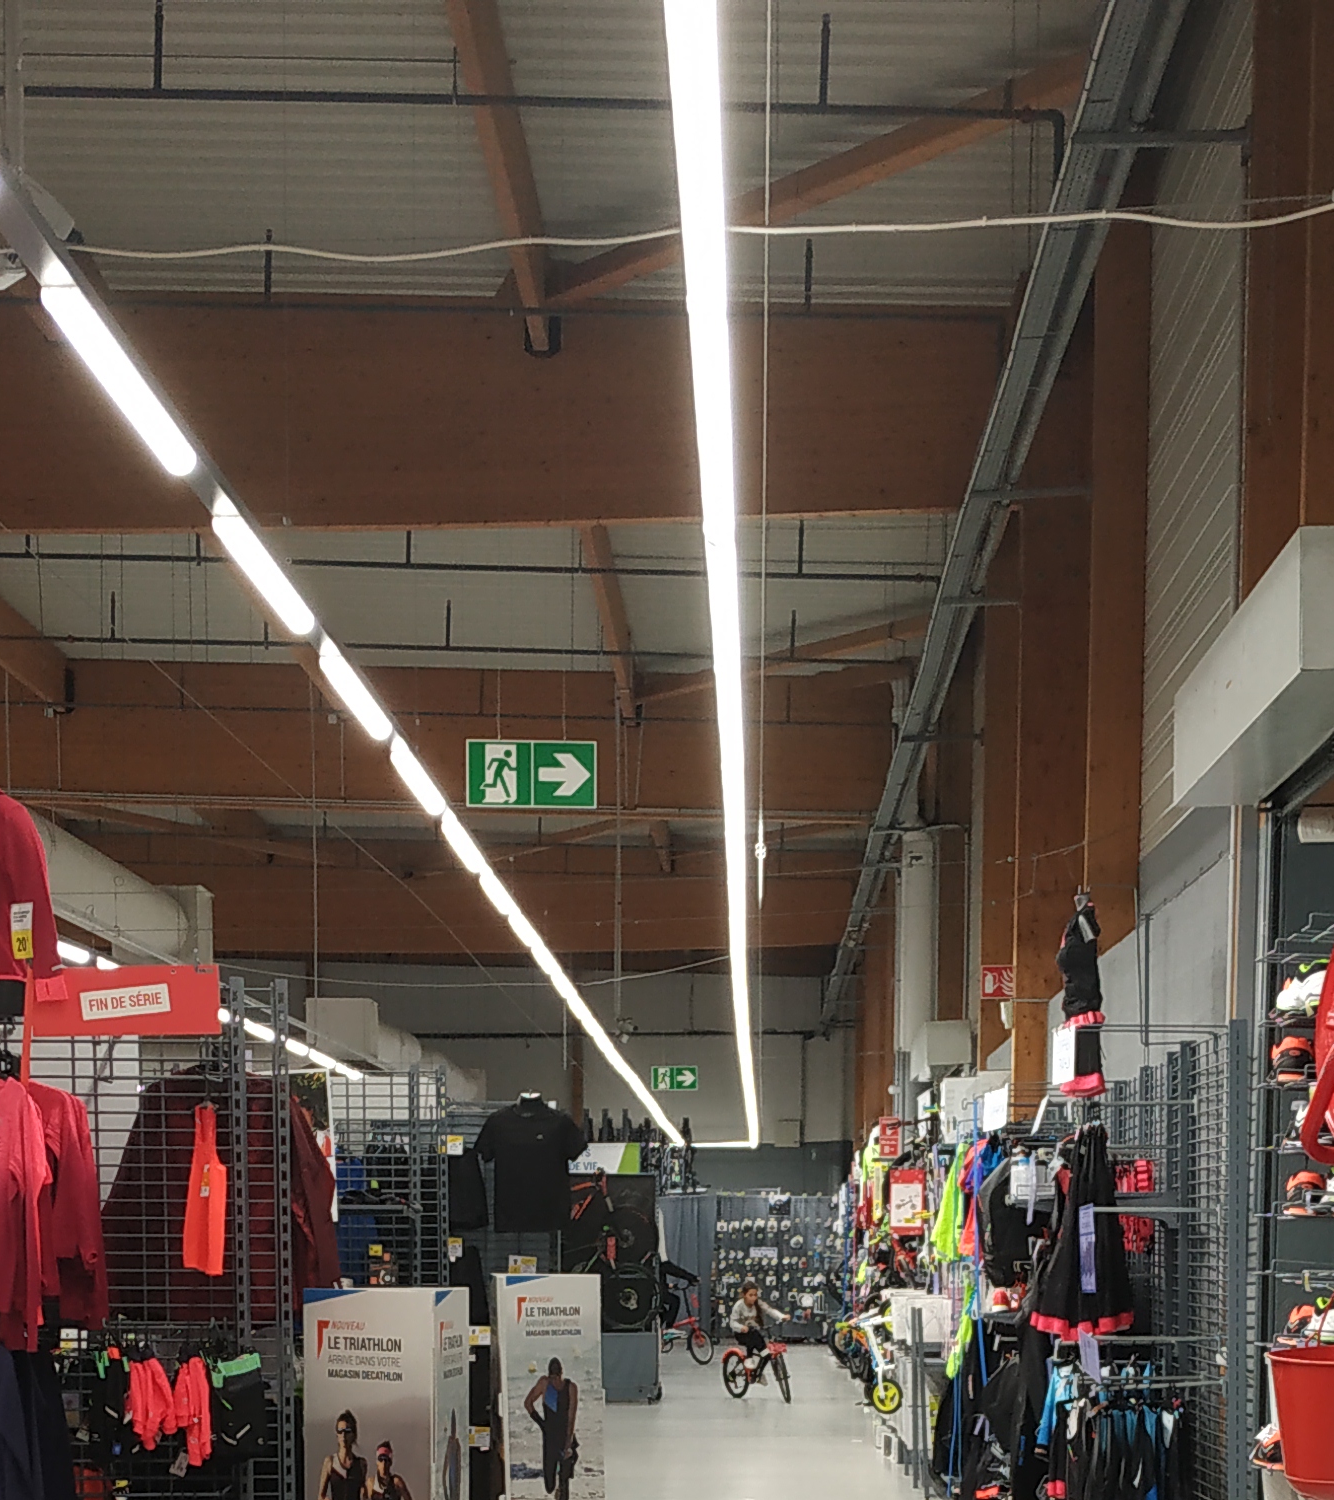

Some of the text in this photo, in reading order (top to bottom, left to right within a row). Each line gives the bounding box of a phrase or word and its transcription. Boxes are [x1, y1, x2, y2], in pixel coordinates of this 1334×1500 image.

[88, 990, 163, 1012] FIN DE SÉRIE
[525, 1306, 581, 1317] LE TRIATHLON
[331, 1321, 366, 1331] NOUVEAU
[328, 1336, 402, 1352] LE TRIATHLON
[328, 1355, 353, 1366] ARRIVE
[377, 1356, 401, 1367] VOTRE
[328, 1368, 403, 1382] MAGASIN DECATHLON
